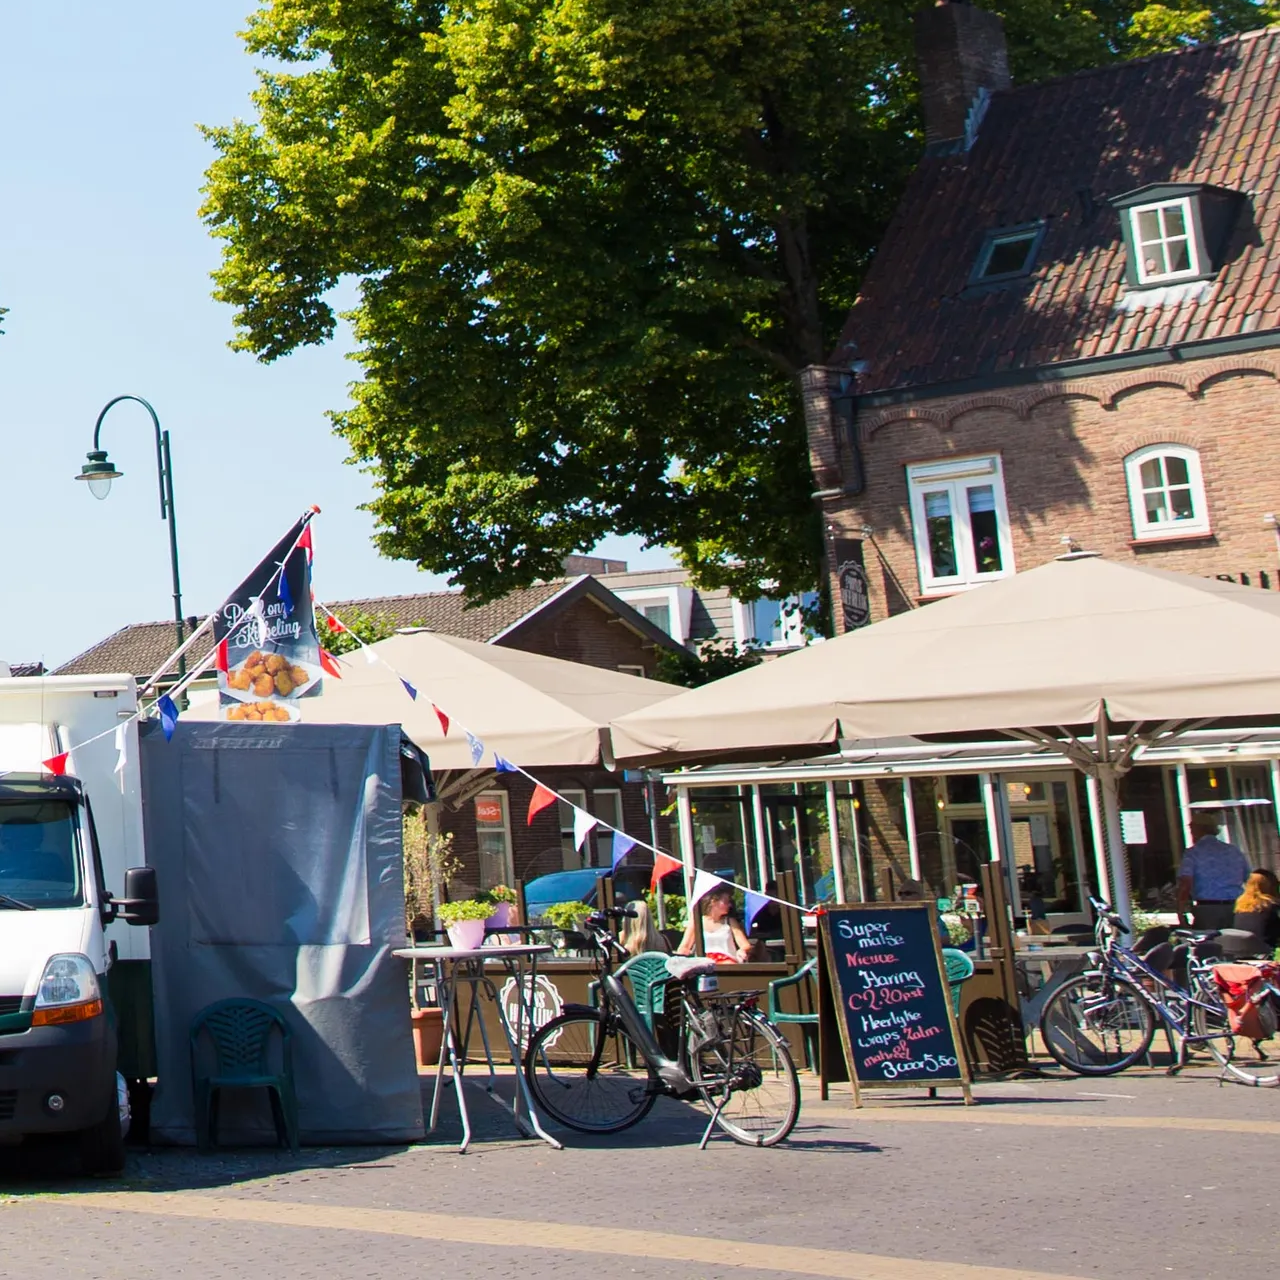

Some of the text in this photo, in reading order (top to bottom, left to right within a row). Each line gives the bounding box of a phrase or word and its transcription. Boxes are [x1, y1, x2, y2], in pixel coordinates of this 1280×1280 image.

[268, 602, 295, 619] onz
[236, 619, 302, 649] Kibeling
[838, 919, 891, 939] Super
[859, 933, 906, 948] malse
[846, 951, 900, 967] Nieuwe
[858, 970, 926, 989] Haring
[858, 1031, 901, 1048] wraps
[881, 1061, 898, 1078] 3
